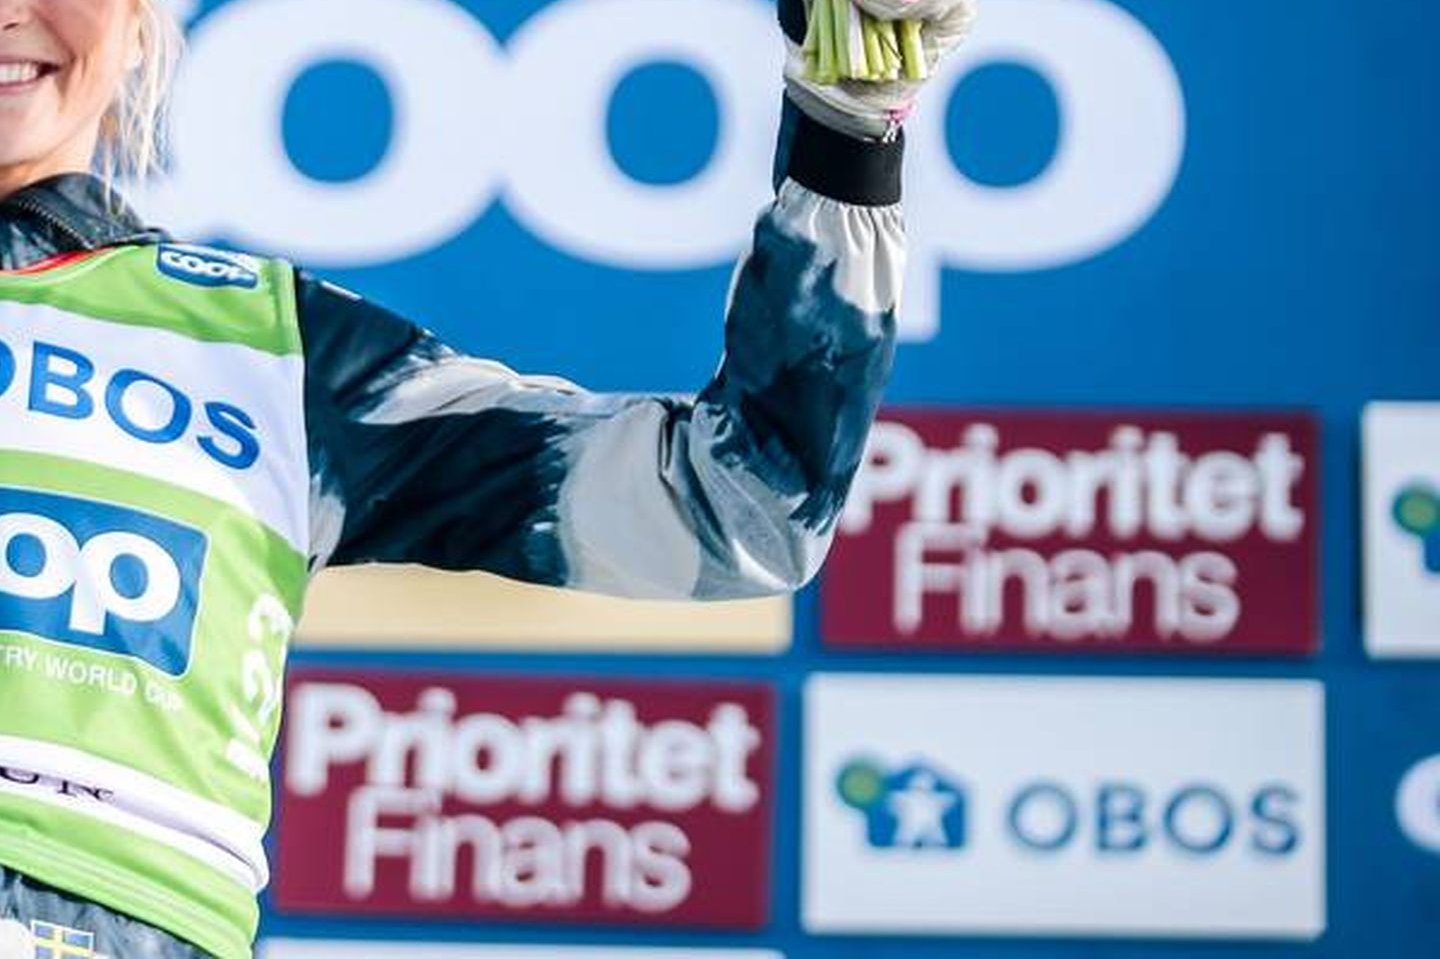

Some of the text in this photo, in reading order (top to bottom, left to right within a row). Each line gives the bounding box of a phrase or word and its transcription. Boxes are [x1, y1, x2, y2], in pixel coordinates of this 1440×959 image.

[834, 421, 1306, 541] Prioritet
[892, 520, 1243, 642] Finans
[44, 654, 138, 695] WORLD
[285, 682, 761, 813] Prioritet
[343, 785, 693, 914] Finans
[1006, 782, 1302, 856] OBOS
